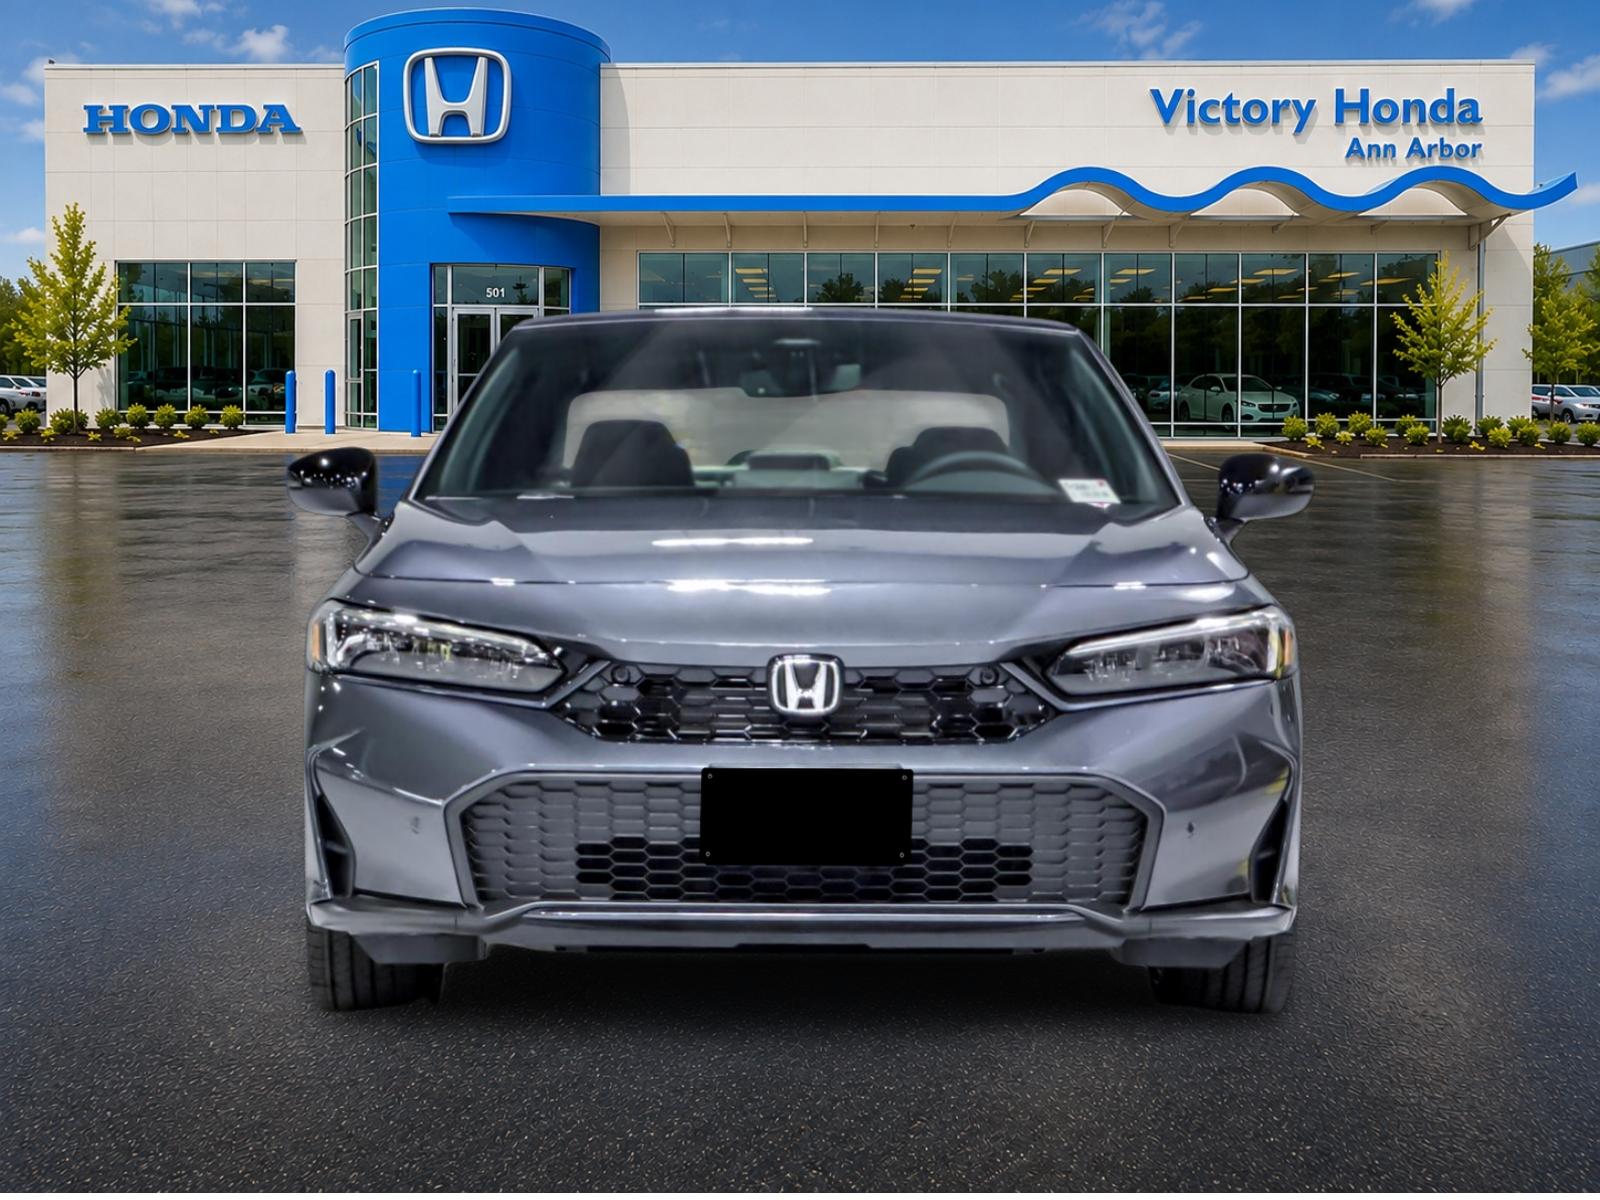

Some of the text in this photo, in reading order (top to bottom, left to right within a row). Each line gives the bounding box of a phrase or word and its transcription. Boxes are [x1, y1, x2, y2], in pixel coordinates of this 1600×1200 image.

[83, 103, 301, 134] HONDA
[1151, 87, 1483, 135] Victory Honda
[1345, 136, 1482, 160] Ann Arbor
[486, 287, 505, 298] 501
